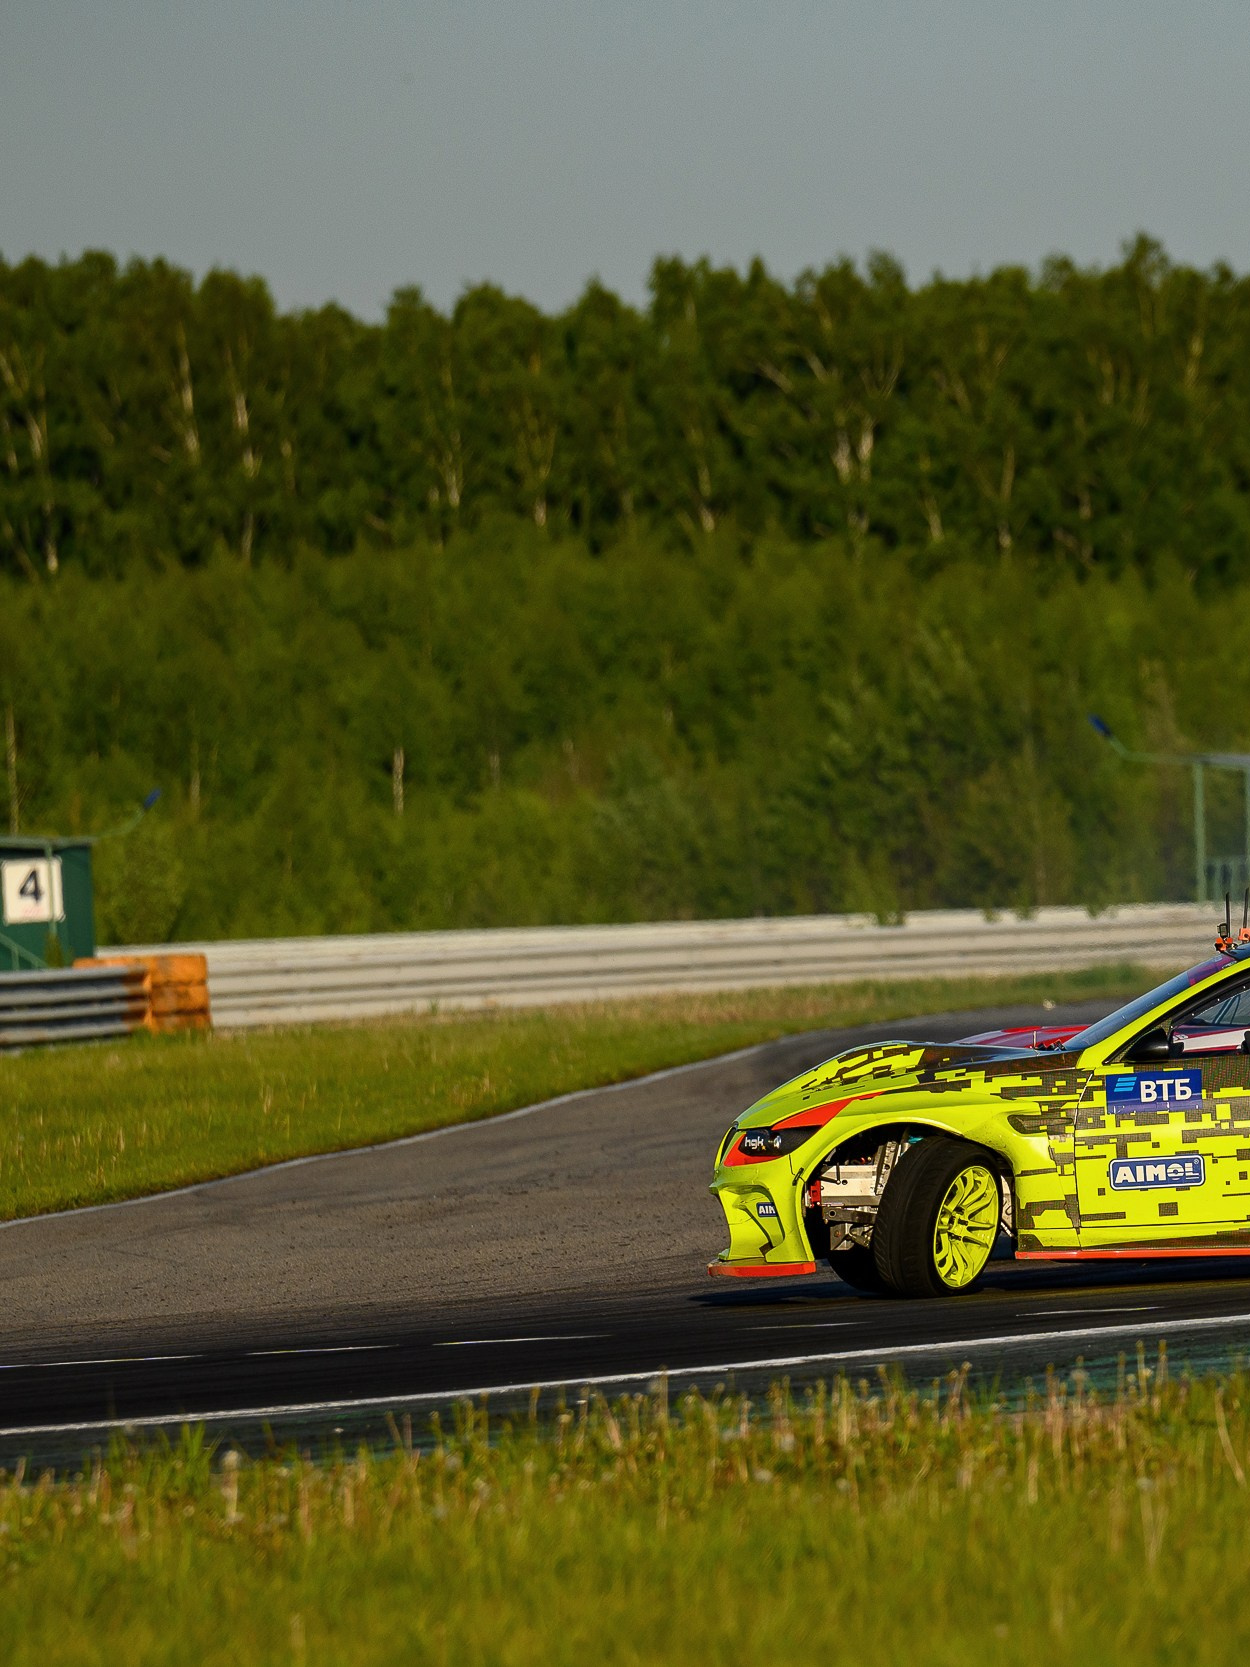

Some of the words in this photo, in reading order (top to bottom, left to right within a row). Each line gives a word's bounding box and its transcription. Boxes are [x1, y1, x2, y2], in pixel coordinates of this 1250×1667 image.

[20, 869, 45, 902] 4
[1140, 1078, 1192, 1102] ВТБ
[744, 1135, 764, 1149] hgk
[1115, 1161, 1199, 1183] AIMOL
